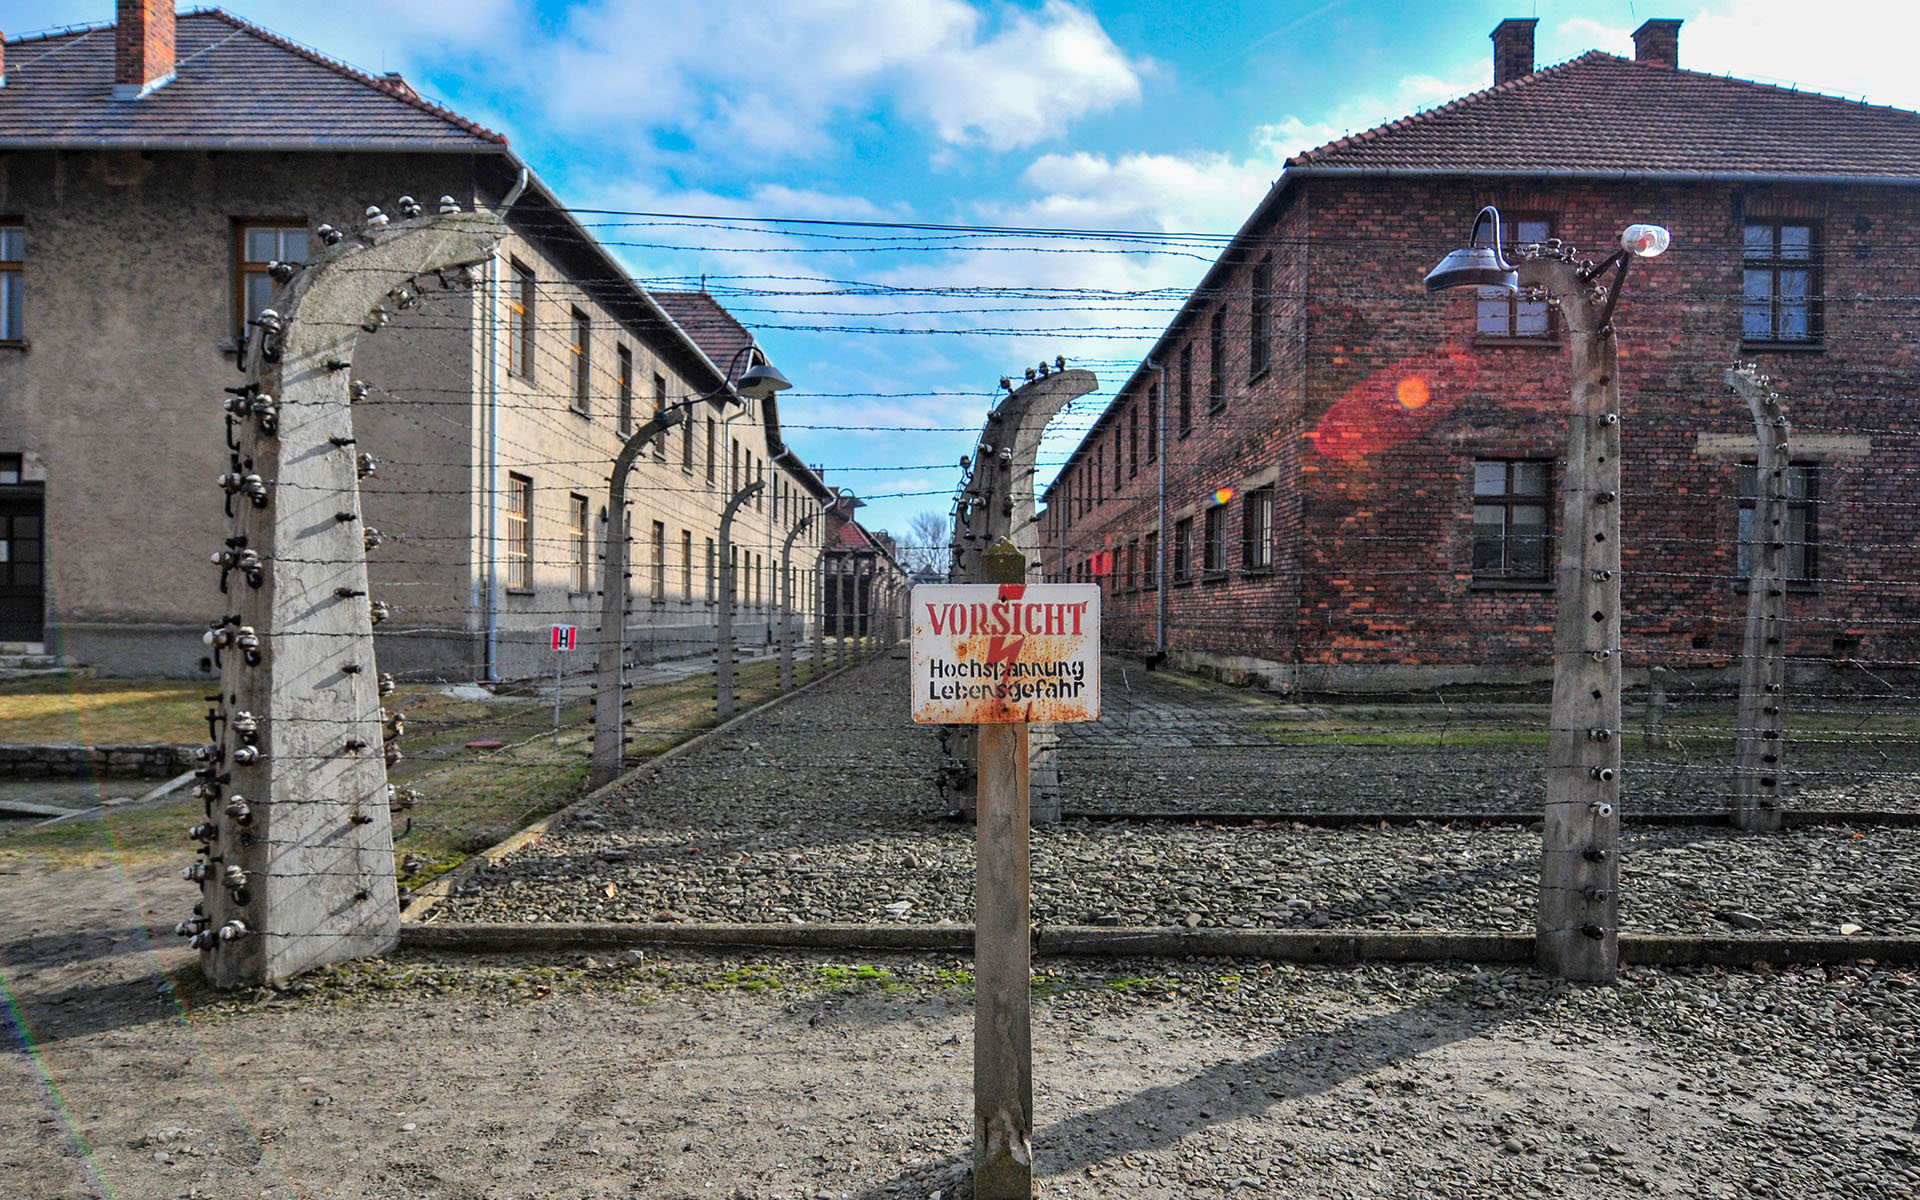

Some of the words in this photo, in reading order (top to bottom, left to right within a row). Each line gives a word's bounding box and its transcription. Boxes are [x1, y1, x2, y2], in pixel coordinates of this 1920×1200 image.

[925, 603, 1087, 636] VORSICHT
[559, 629, 569, 648] H
[930, 659, 1085, 681] Hochspannung
[930, 679, 1086, 703] Lebensgefahr
